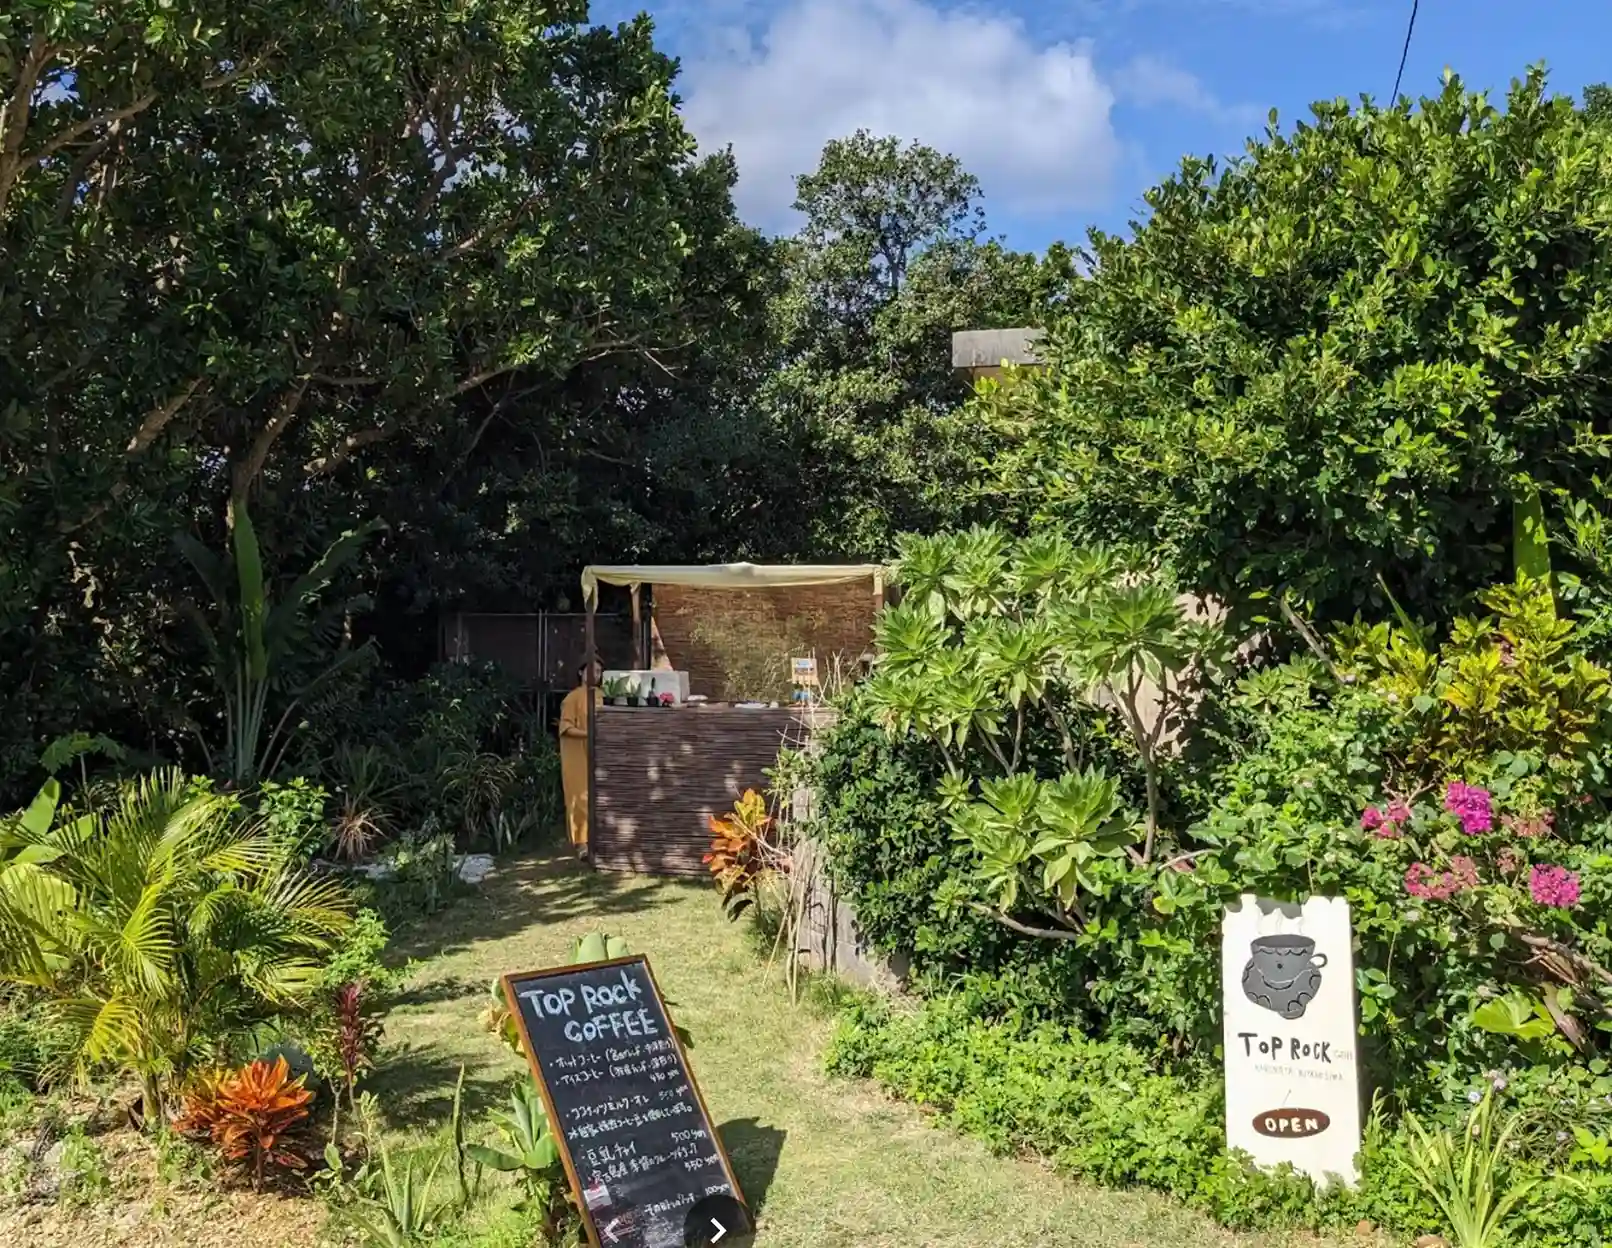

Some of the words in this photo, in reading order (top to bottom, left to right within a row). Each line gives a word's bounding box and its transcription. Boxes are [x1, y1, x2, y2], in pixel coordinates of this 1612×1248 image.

[518, 987, 576, 1019] TOP
[563, 1008, 659, 1042] COFFEE
[1264, 1117, 1319, 1133] OPEN
